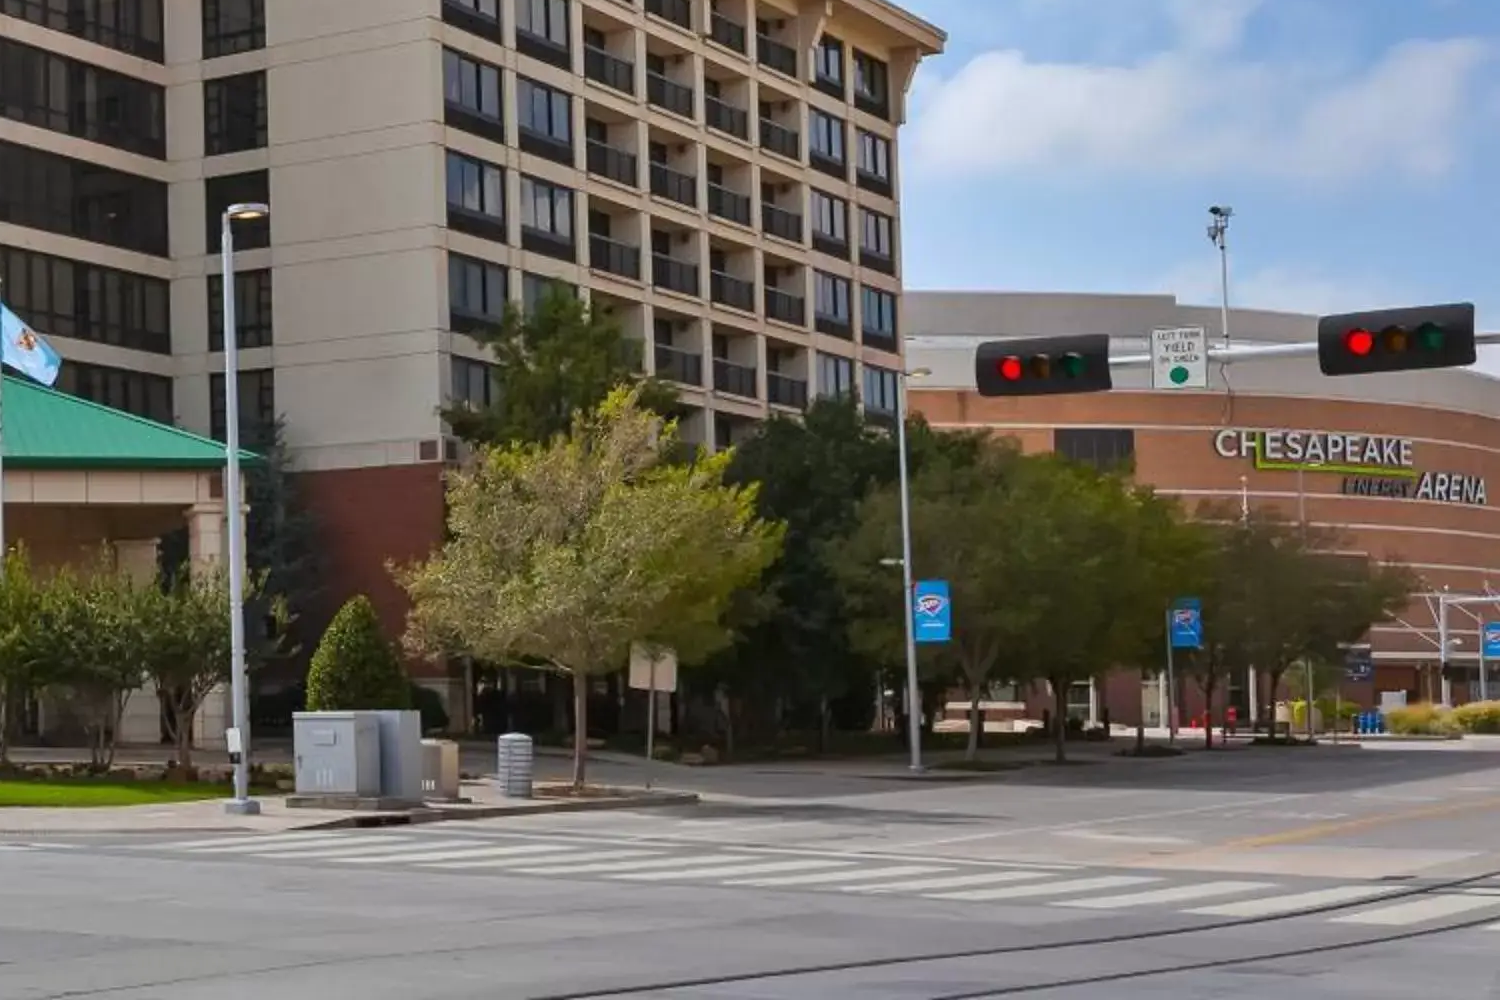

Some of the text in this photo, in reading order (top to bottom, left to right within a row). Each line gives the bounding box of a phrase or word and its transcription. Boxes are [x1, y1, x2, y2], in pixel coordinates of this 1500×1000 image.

[1163, 341, 1196, 353] YIELD
[1215, 429, 1414, 466] CHESAPEAKE
[1416, 472, 1488, 504] ARENA
